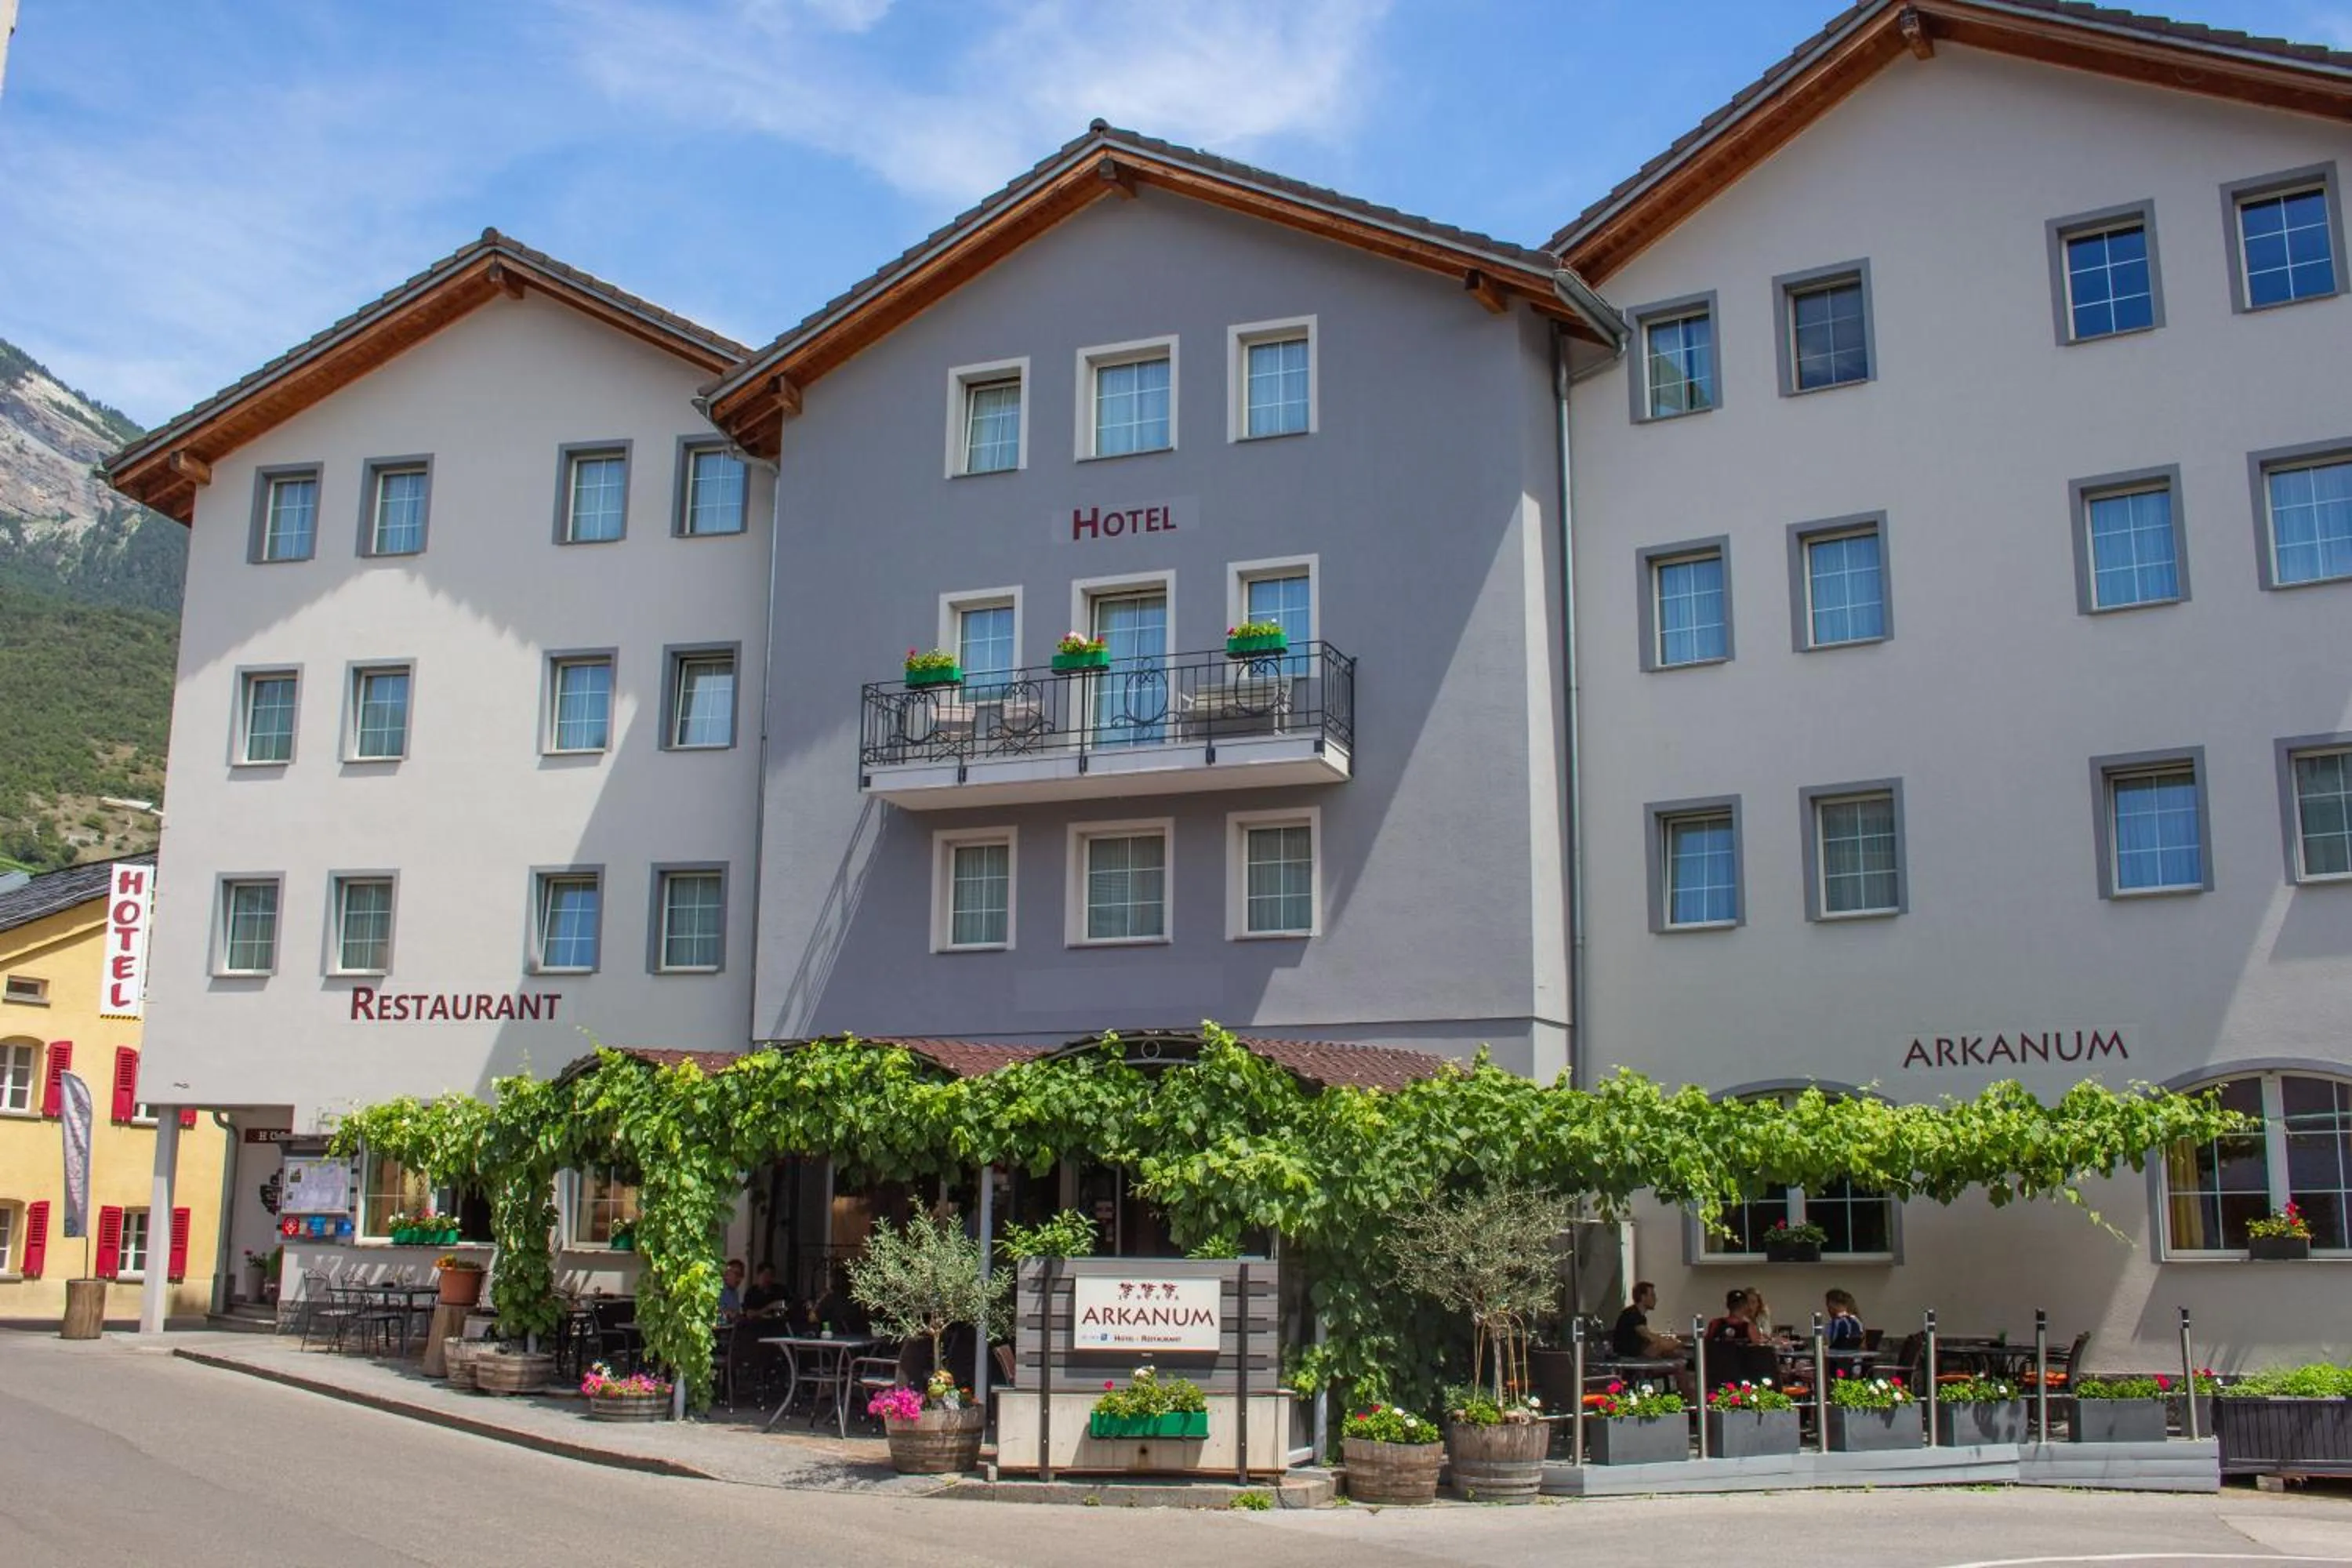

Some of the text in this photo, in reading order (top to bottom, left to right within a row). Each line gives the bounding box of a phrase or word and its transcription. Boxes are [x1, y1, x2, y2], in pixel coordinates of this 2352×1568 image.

[1073, 506, 1177, 540] HOTEL
[111, 870, 143, 1007] HOTEL
[350, 986, 562, 1020] RESTAURANT
[1903, 1029, 2129, 1069] ARKANUM
[1081, 1306, 1214, 1327] ARKANUM
